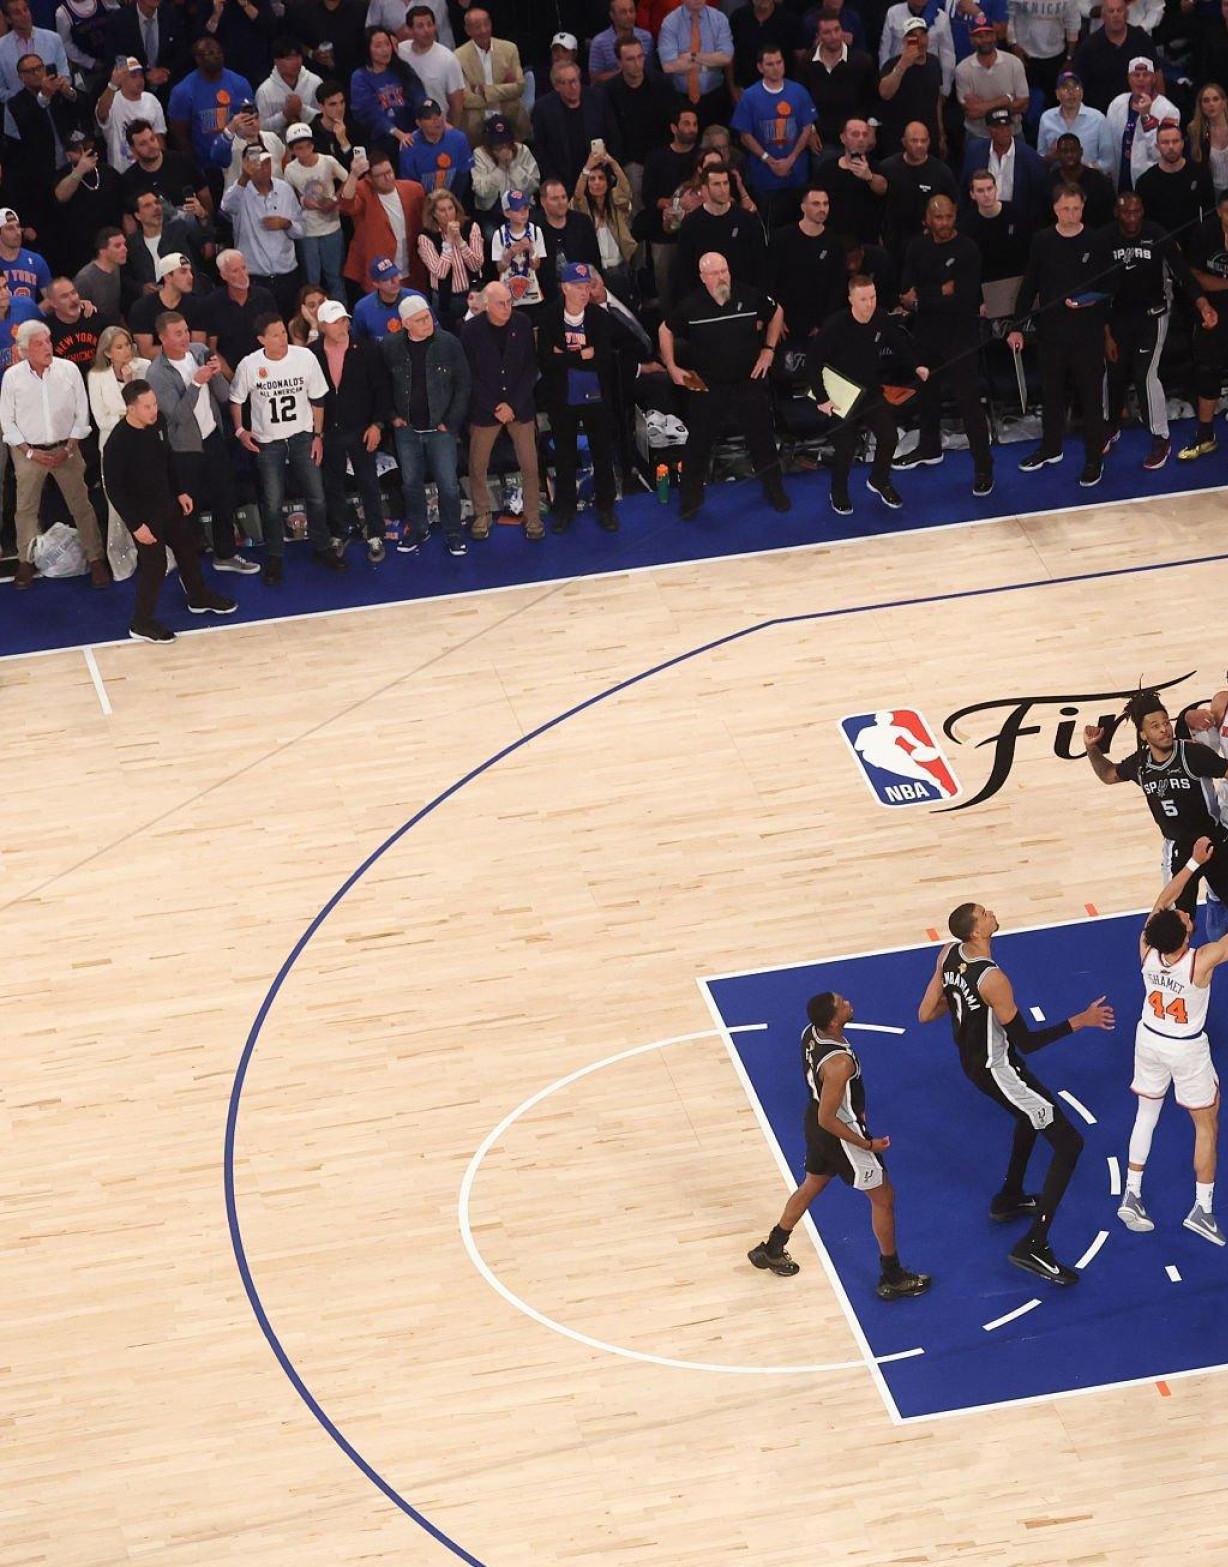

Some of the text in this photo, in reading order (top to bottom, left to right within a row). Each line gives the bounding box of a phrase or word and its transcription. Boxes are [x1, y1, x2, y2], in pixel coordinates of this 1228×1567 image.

[256, 376, 305, 390] McDONALD'S
[268, 395, 297, 424] 12
[884, 781, 931, 803] NBA
[1143, 777, 1191, 798] SPURS
[1161, 799, 1179, 817] 5
[1148, 990, 1189, 1024] 44
